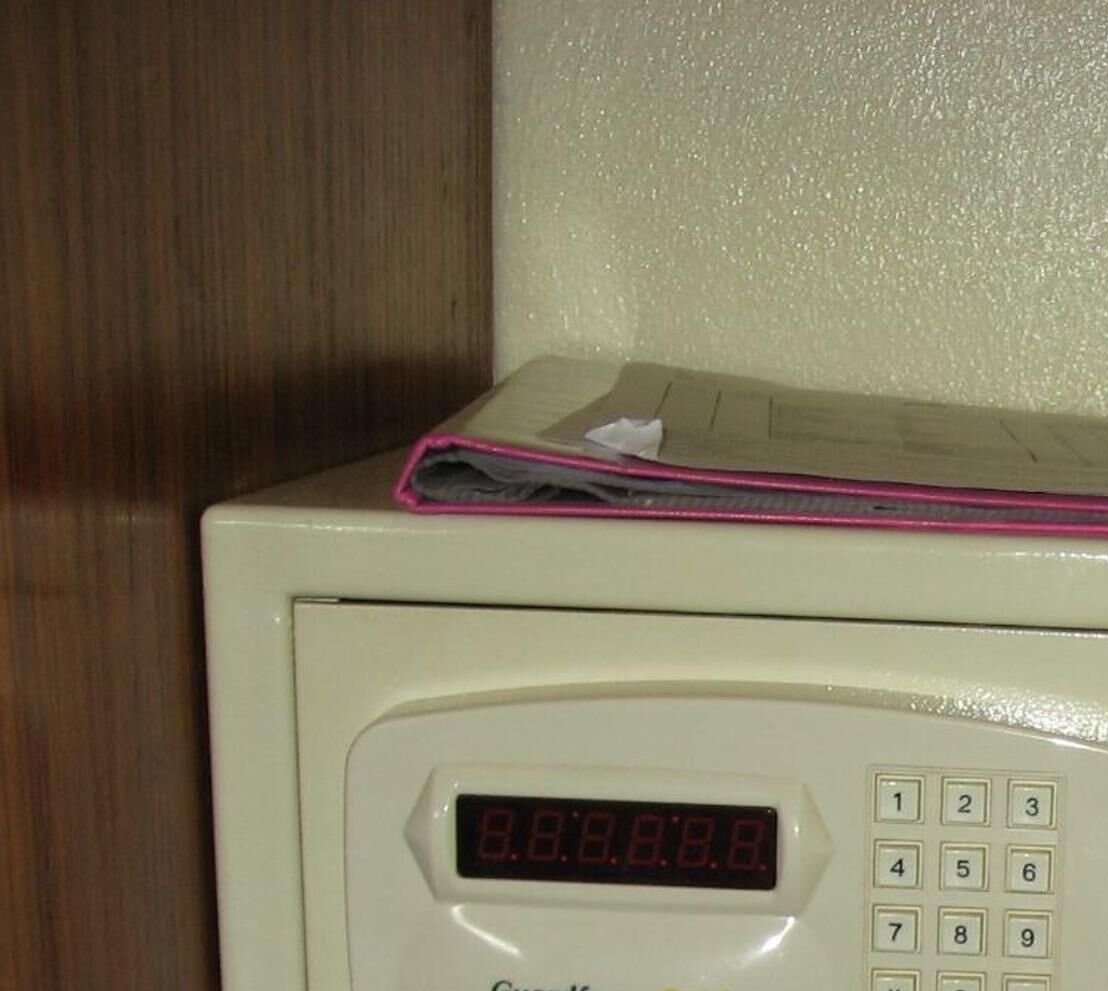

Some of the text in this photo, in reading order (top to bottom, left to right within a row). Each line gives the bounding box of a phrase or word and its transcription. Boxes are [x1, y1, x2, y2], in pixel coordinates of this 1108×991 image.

[893, 792, 1039, 816] 1 2 3
[890, 858, 1036, 882] 4 5 6
[888, 923, 1035, 947] 7 8 9
